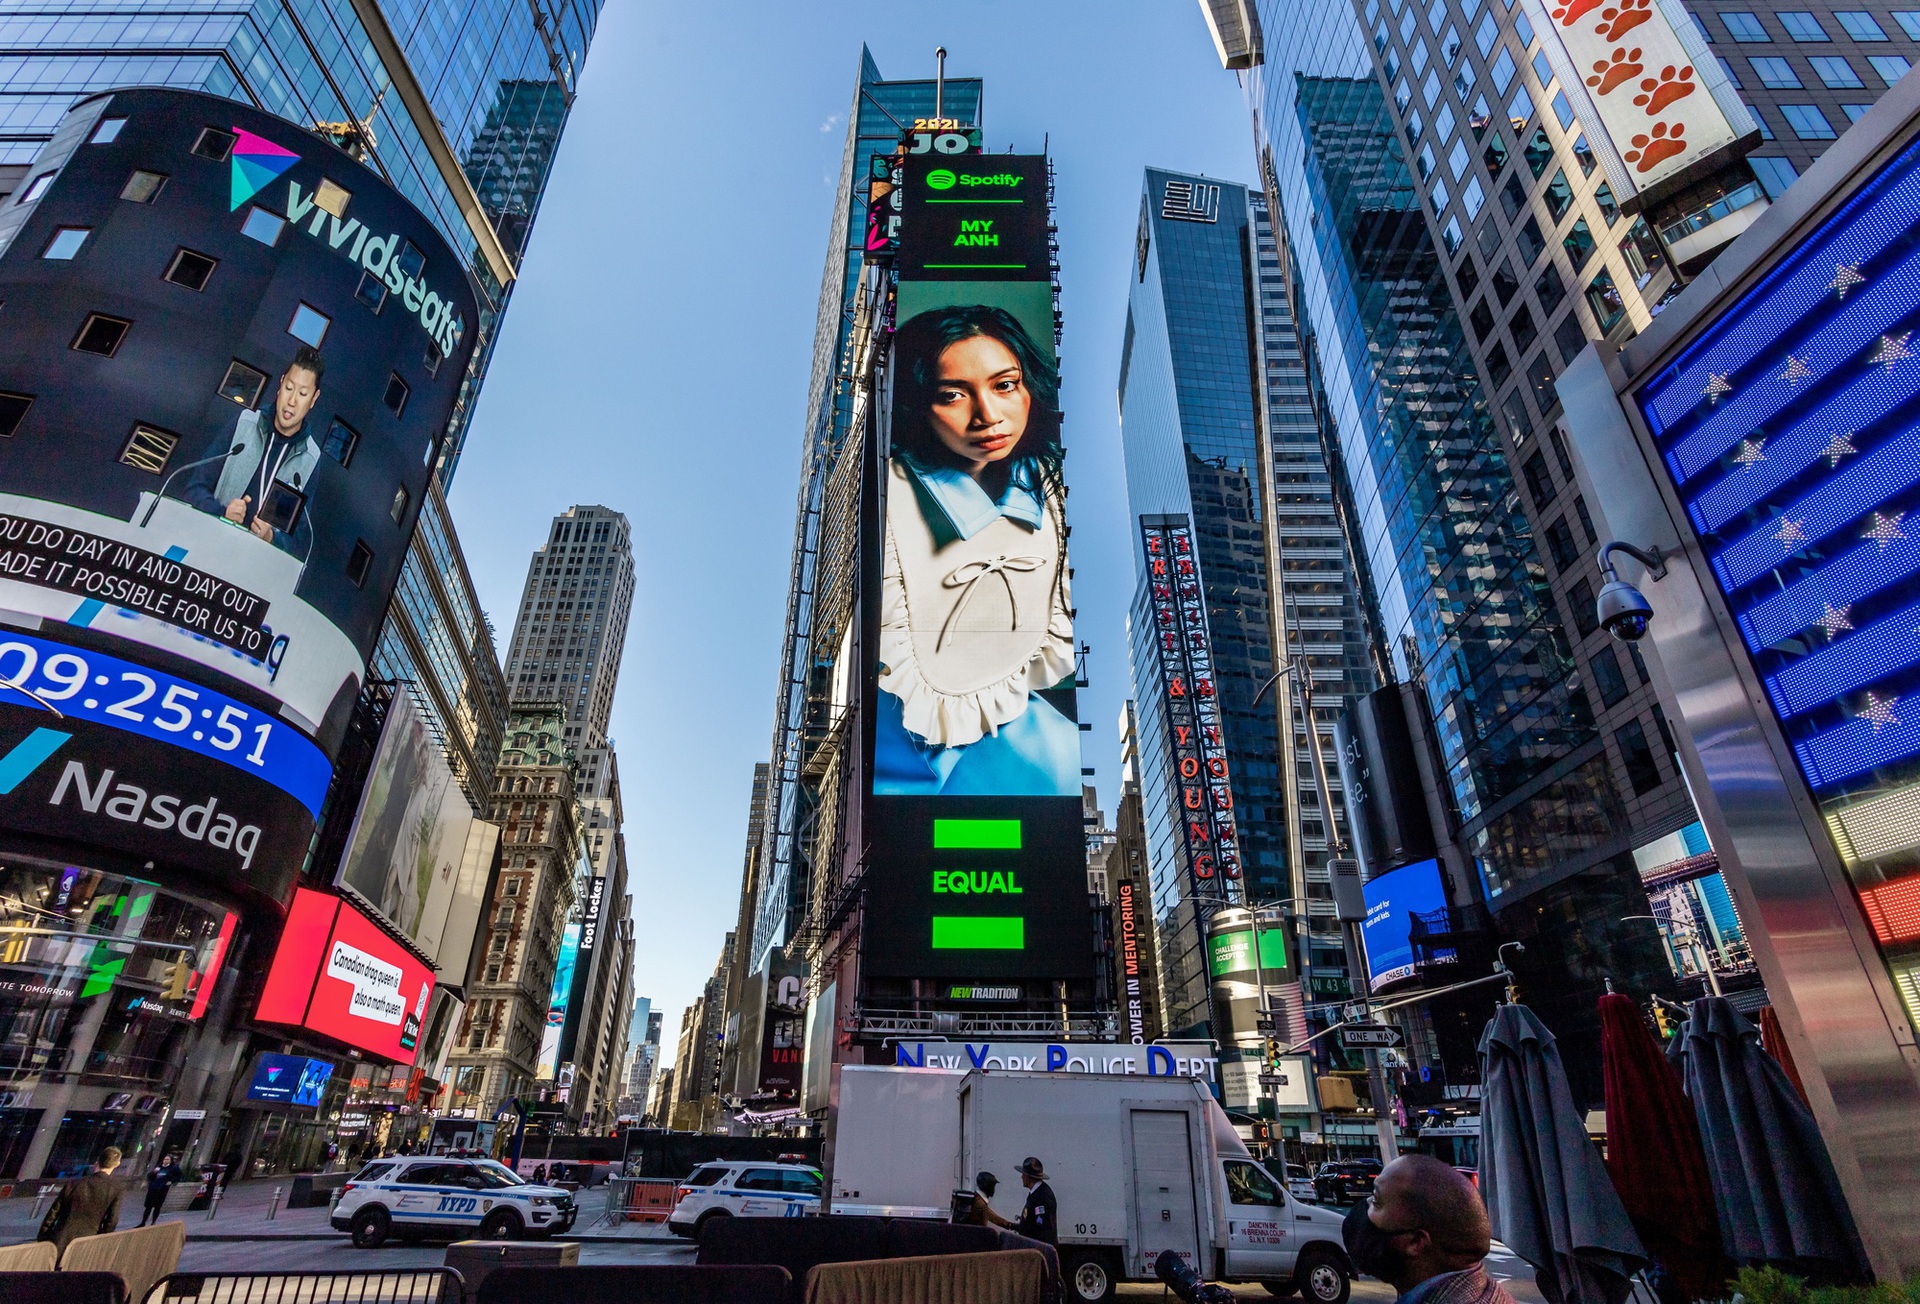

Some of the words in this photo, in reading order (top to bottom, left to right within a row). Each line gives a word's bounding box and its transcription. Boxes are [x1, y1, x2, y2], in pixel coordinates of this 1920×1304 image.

[959, 174, 1020, 187] Spotify
[961, 220, 993, 232] MY
[953, 234, 998, 247] ANH
[0, 517, 27, 540] OU
[27, 524, 64, 549] DO
[66, 534, 112, 561] DAY
[111, 546, 138, 570] IN
[137, 556, 182, 584] AND
[184, 571, 222, 600] DAY
[223, 587, 259, 616] OUT
[0, 550, 46, 578] ADE
[45, 561, 73, 583] IT
[71, 567, 172, 615] POSSIBLE
[172, 599, 210, 630] FOR
[213, 614, 238, 640] US
[240, 625, 261, 650] TO
[1150, 536, 1175, 650] ERNST
[1169, 677, 1186, 697] &
[0, 641, 273, 767] 09:25:51
[1177, 726, 1213, 879] YOUNG
[49, 760, 262, 870] Nasdaq
[933, 871, 1023, 894] EQUAL
[585, 879, 605, 919] Locker
[580, 922, 596, 949] Foot
[1120, 884, 1138, 975] MENTORING
[1215, 942, 1249, 955] CHALLENGE
[1216, 951, 1246, 962] ACCEPTED
[334, 948, 364, 976] Canadian
[364, 961, 378, 986] drag
[377, 970, 394, 987] queen
[393, 972, 399, 988] is
[1385, 969, 1404, 981] CHASE
[19, 983, 74, 997] TOMORROW
[1127, 978, 1140, 995] IN
[1312, 979, 1321, 991] W
[1326, 979, 1338, 991] 43
[140, 1000, 163, 1013] Nasdaq
[354, 988, 367, 1007] also
[366, 996, 372, 1008] a
[371, 995, 386, 1013] math
[1129, 999, 1144, 1045] OWER
[1350, 1032, 1368, 1041] ONE
[1376, 1032, 1395, 1041] WAY
[1146, 1045, 1219, 1083] DEPT
[436, 1196, 478, 1214] NYPD
[1075, 1223, 1087, 1235] 10
[1090, 1224, 1098, 1235] 3
[1247, 1229, 1270, 1237] BRIENNA
